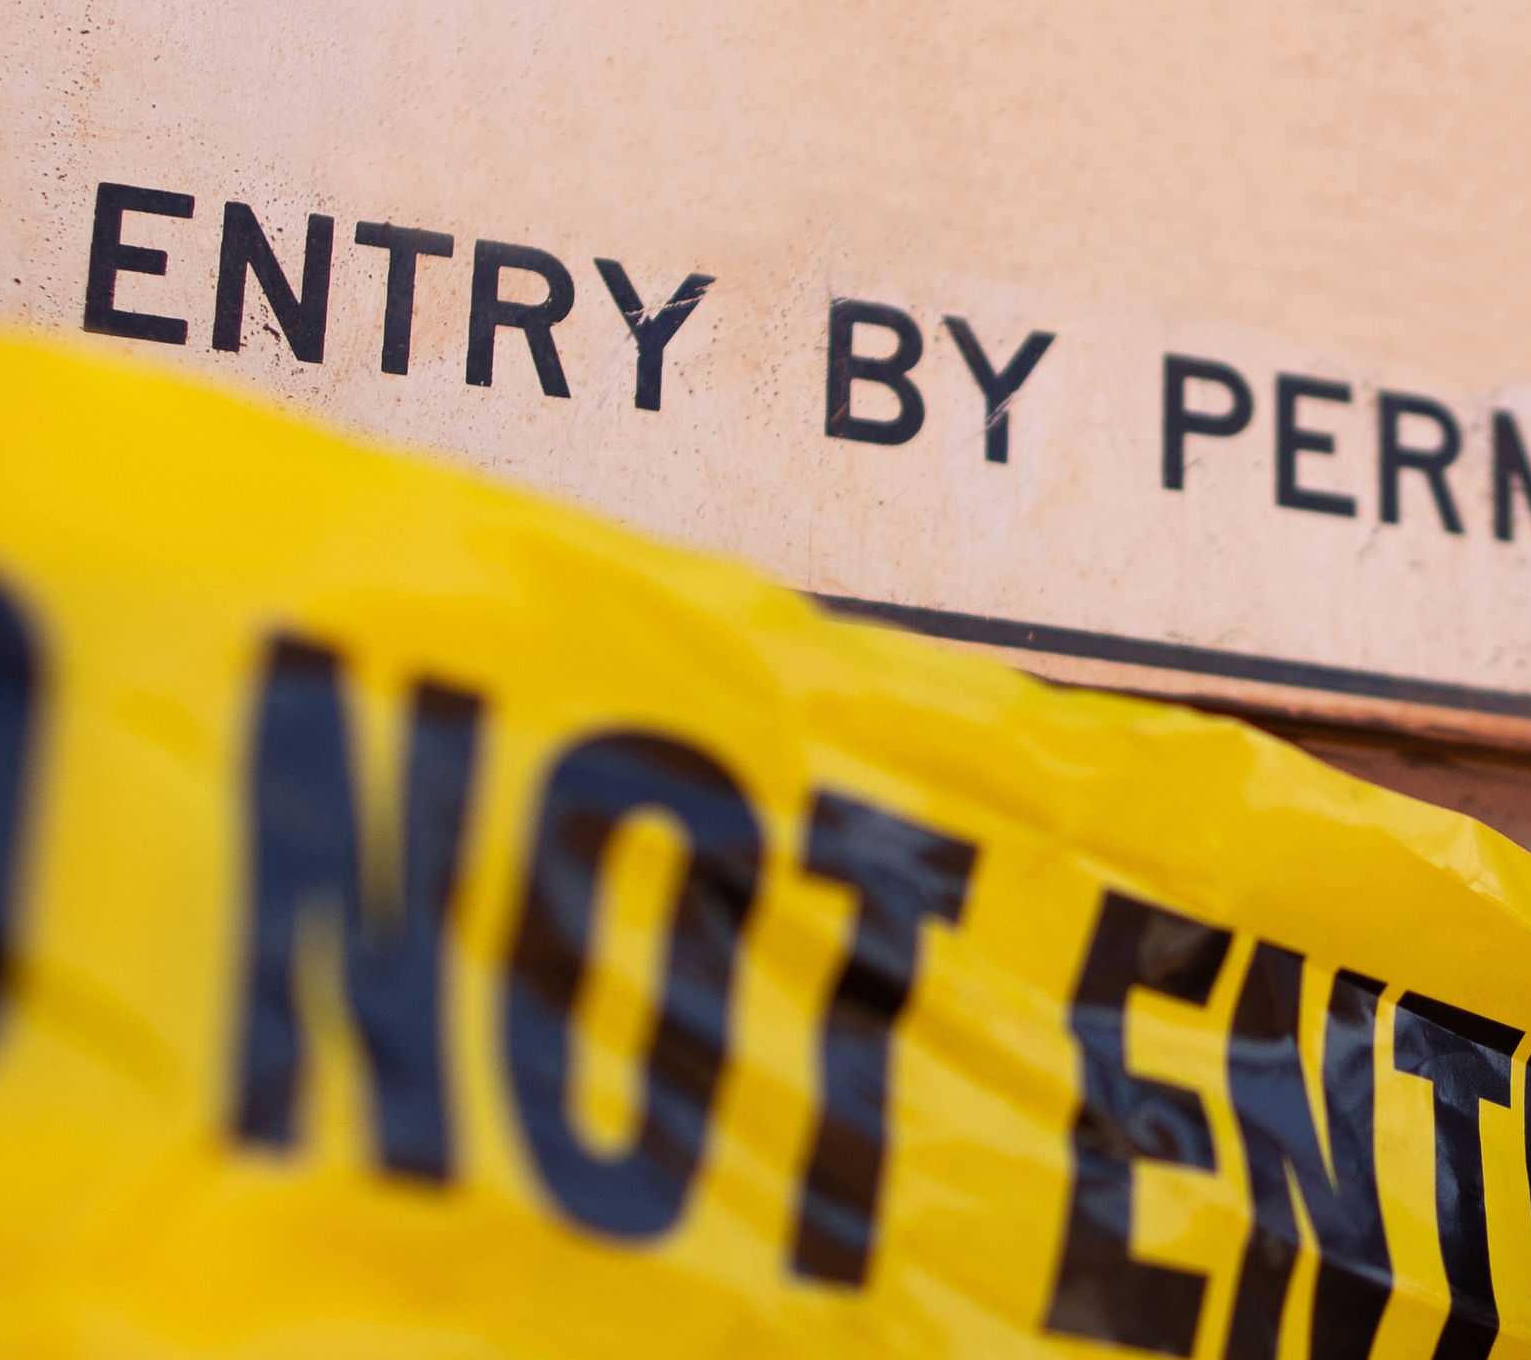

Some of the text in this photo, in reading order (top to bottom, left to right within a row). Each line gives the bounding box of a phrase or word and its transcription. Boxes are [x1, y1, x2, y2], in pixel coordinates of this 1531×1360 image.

[80, 180, 718, 415] ENTRY
[821, 297, 1059, 467] BY
[226, 629, 981, 1294] NOT
